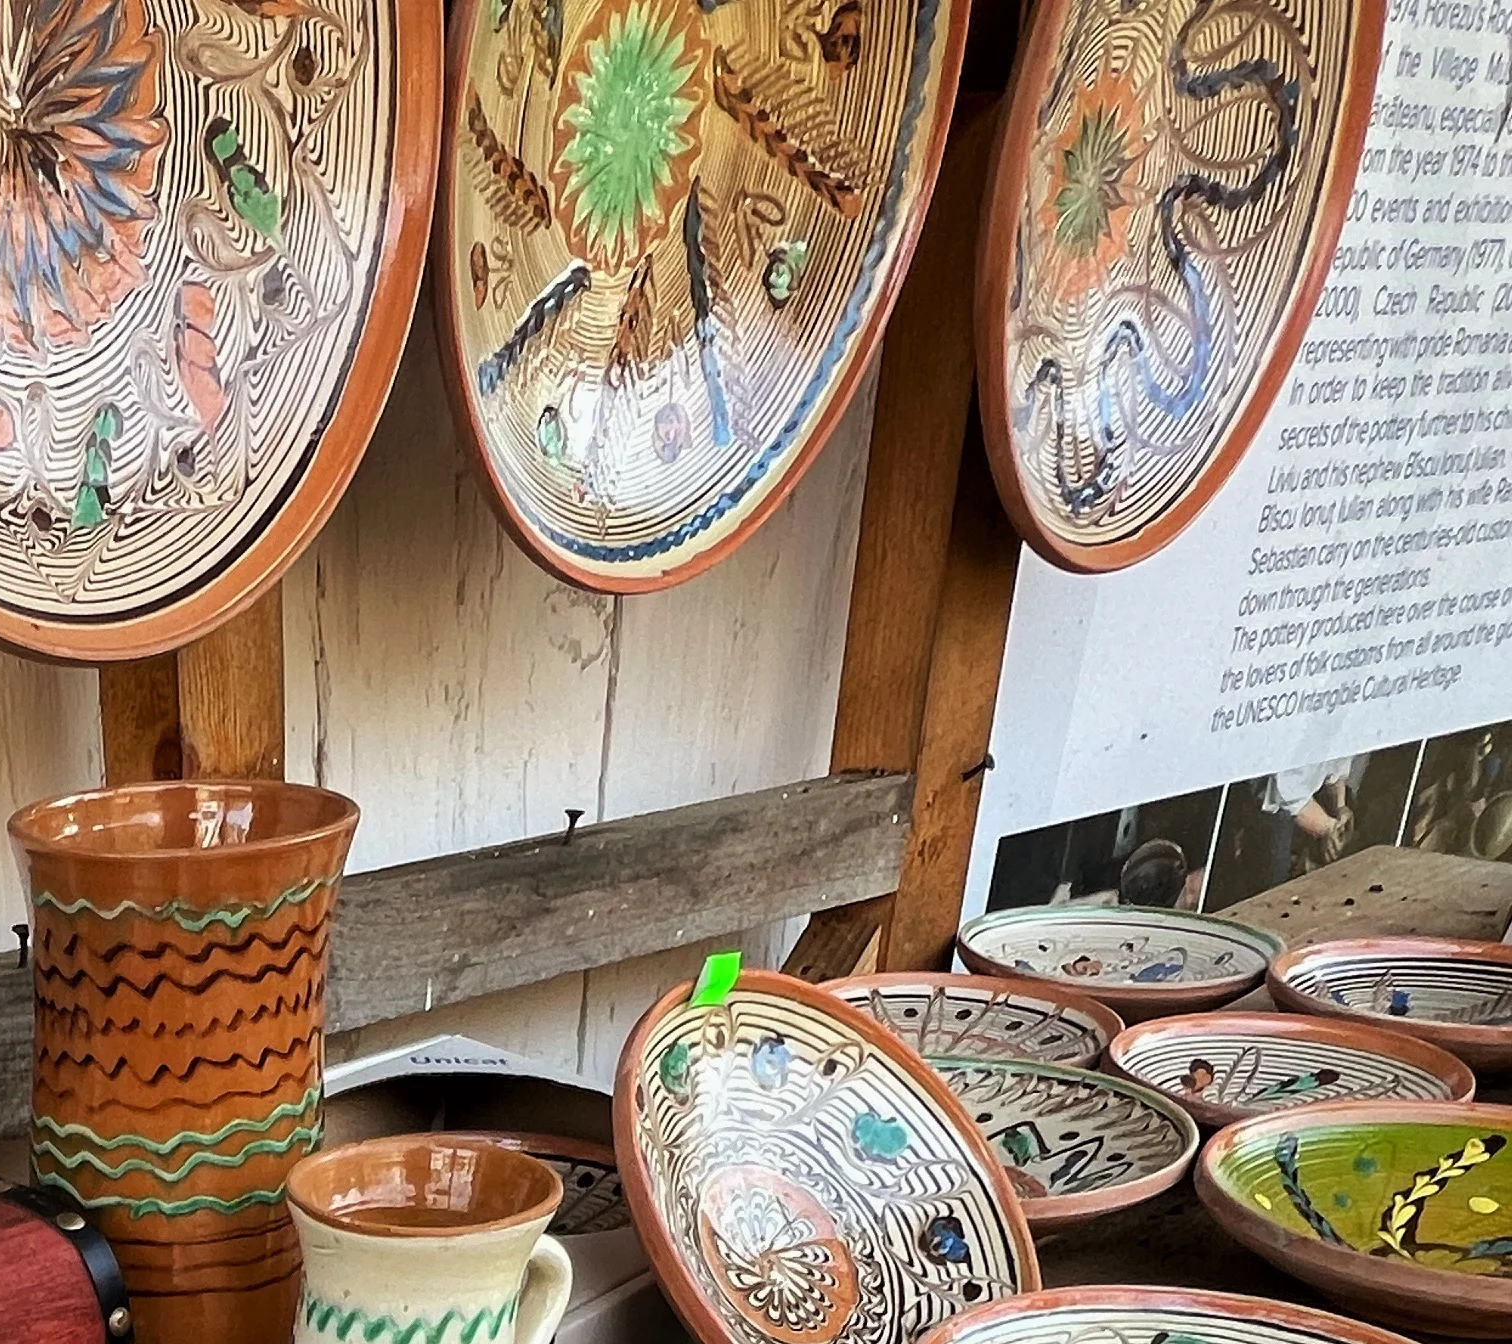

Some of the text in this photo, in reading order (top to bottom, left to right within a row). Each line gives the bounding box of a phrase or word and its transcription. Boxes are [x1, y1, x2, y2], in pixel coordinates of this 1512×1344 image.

[1396, 44, 1422, 78] the
[1431, 46, 1479, 91] Village
[1387, 142, 1413, 175] the
[1411, 148, 1448, 183] year
[1449, 144, 1484, 177] 1974
[1482, 147, 1498, 178] to
[1370, 194, 1420, 223] events
[1422, 191, 1456, 223] and
[1387, 238, 1407, 270] of
[1404, 238, 1467, 276] Germany
[1373, 284, 1418, 317] Czech
[1426, 284, 1485, 320] Republic
[1299, 327, 1509, 369] representing with pride Romania
[1291, 376, 1305, 405] In
[1308, 375, 1349, 405] order
[1351, 373, 1367, 402] to
[1370, 371, 1407, 404] keep
[1410, 369, 1433, 398] the
[1437, 365, 1489, 395] tradition
[1279, 421, 1330, 450] secrets
[1331, 416, 1350, 446] of
[1346, 420, 1370, 444] the
[1368, 414, 1416, 448] pottery
[1418, 409, 1460, 440] further
[1459, 413, 1474, 435] to
[1473, 406, 1492, 434] his
[1301, 459, 1331, 491] and
[1329, 459, 1348, 488] his
[1348, 455, 1404, 489] nephew
[1376, 491, 1414, 523] along
[1415, 485, 1444, 513] with
[1443, 482, 1464, 509] his
[1468, 478, 1494, 506] wife
[1248, 541, 1317, 576] Sebastian
[1317, 540, 1354, 569] carry
[1353, 537, 1371, 561] on
[1371, 532, 1394, 558] the
[1395, 519, 1476, 555] centuries-old
[1238, 590, 1278, 617] down
[1278, 579, 1332, 611] through
[1331, 574, 1354, 602] the
[1231, 625, 1257, 653] The
[1258, 617, 1311, 654] pottery
[1308, 603, 1378, 646] produced
[1376, 602, 1406, 630] here
[1406, 598, 1437, 623] over
[1436, 592, 1457, 616] the
[1458, 587, 1500, 614] course
[1219, 666, 1244, 694] the
[1245, 660, 1287, 687] lovers
[1289, 650, 1308, 680] of
[1306, 650, 1332, 678] folk
[1331, 642, 1386, 672] customs
[1384, 635, 1416, 662] from
[1415, 630, 1433, 656] all
[1431, 624, 1473, 652] around
[1471, 621, 1495, 647] the
[1211, 705, 1235, 733] the
[1236, 689, 1297, 728] UNESCO
[1296, 678, 1361, 714] Intangible
[1362, 671, 1410, 702] Cultural
